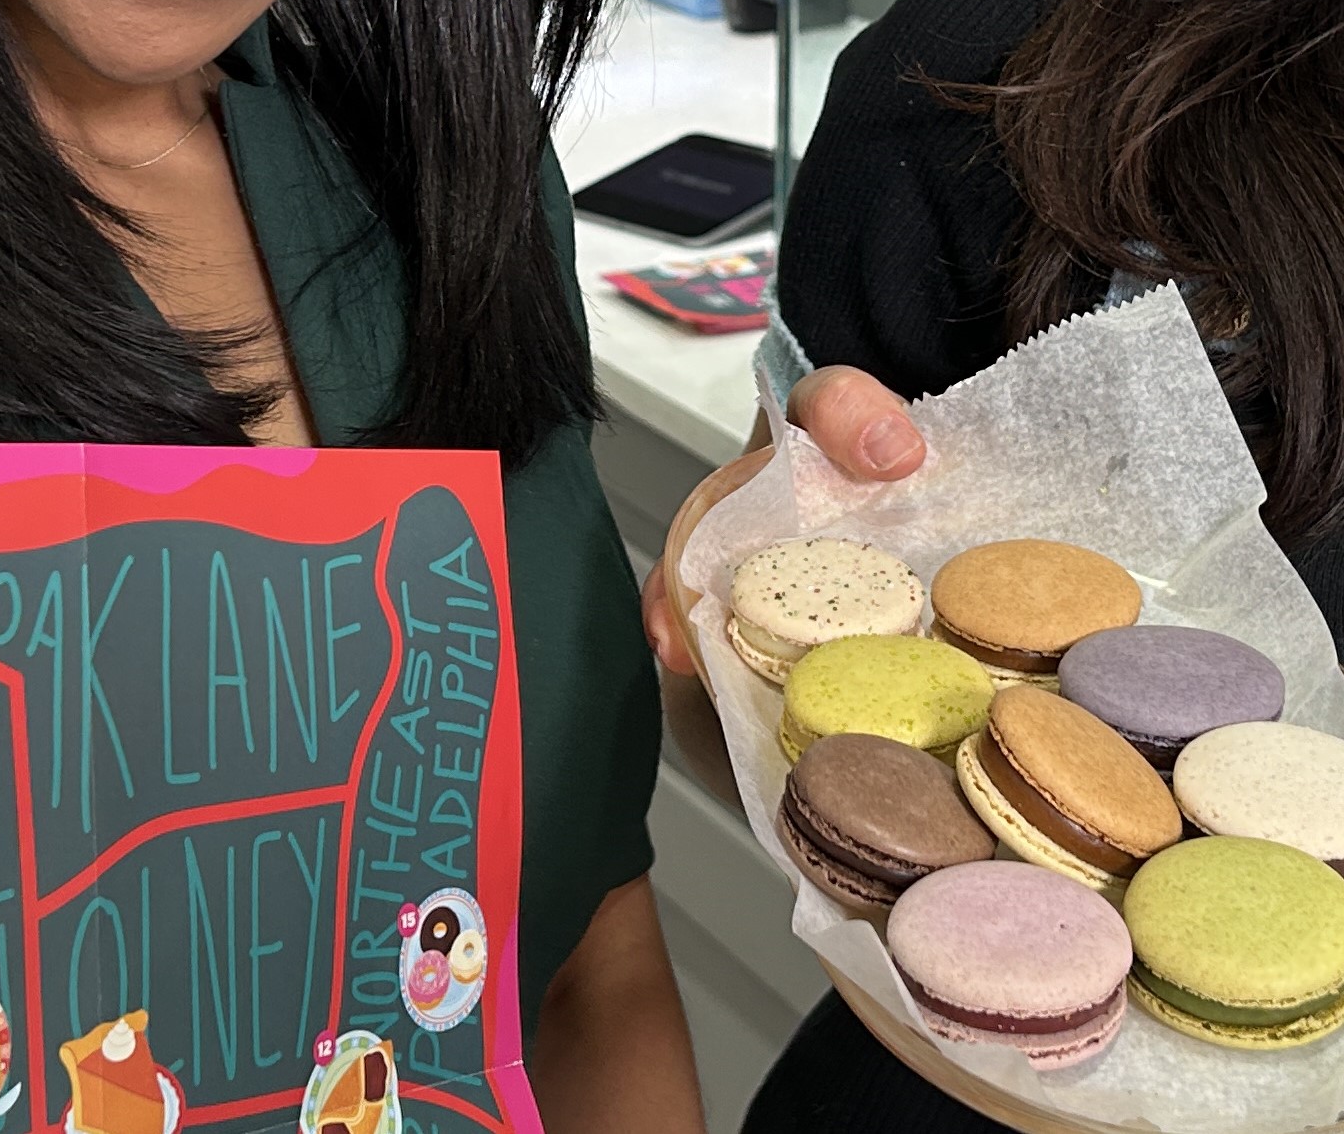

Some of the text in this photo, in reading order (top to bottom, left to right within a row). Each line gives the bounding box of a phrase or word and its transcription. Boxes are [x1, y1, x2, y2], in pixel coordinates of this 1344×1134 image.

[161, 548, 364, 786] LANE
[69, 818, 325, 1087] OLNEY
[399, 911, 416, 929] 15
[317, 1040, 334, 1058] 12
